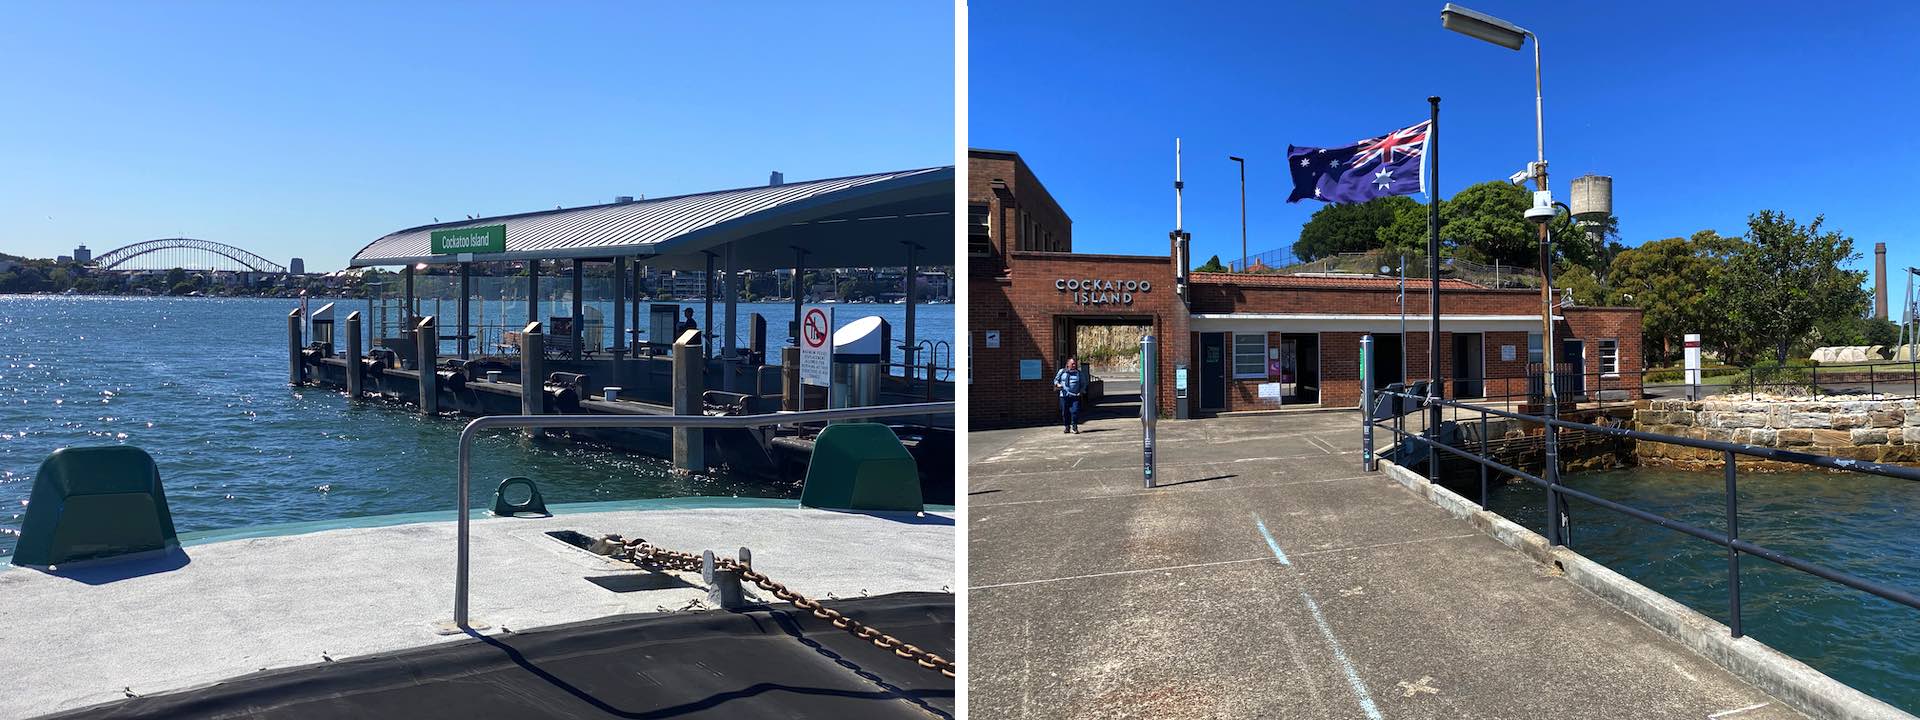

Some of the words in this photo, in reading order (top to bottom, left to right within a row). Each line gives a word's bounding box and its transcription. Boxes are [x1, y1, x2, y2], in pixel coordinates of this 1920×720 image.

[442, 235, 469, 249] Cockatoo
[470, 232, 489, 247] Island
[1055, 279, 1151, 291] COCKATOO
[1074, 291, 1133, 304] ISLAND
